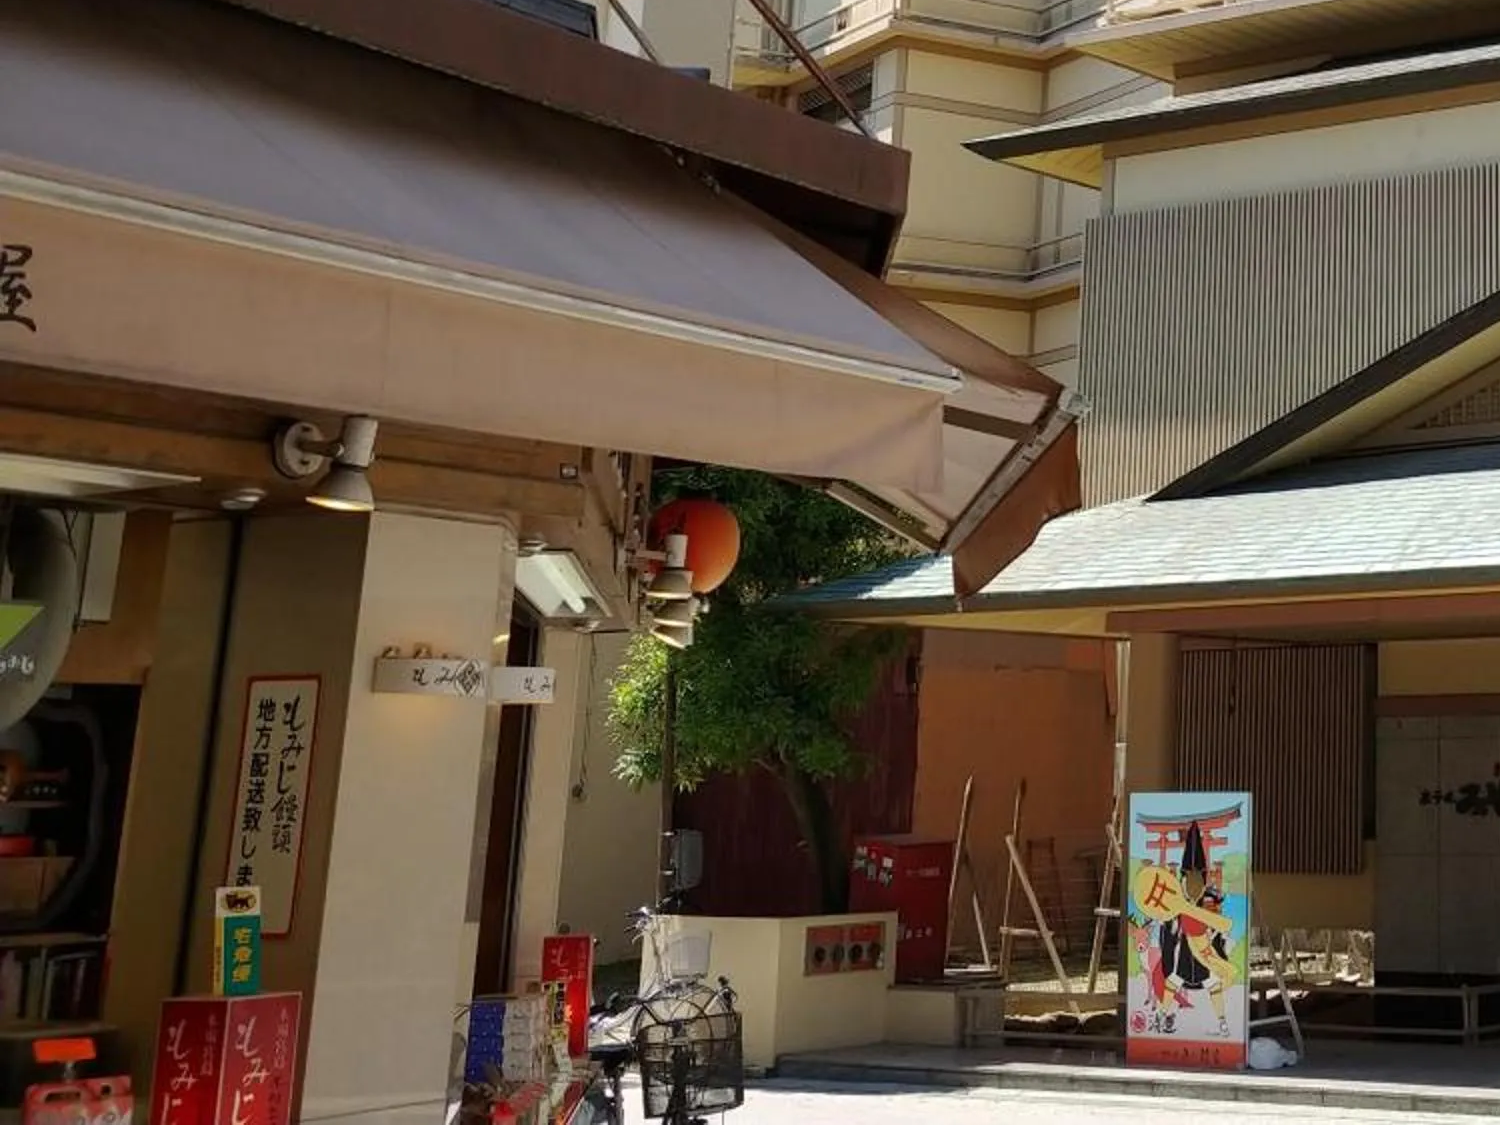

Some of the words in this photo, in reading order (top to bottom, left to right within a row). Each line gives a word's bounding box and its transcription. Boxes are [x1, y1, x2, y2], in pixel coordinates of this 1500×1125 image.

[270, 694, 306, 854] もみじ饅頭
